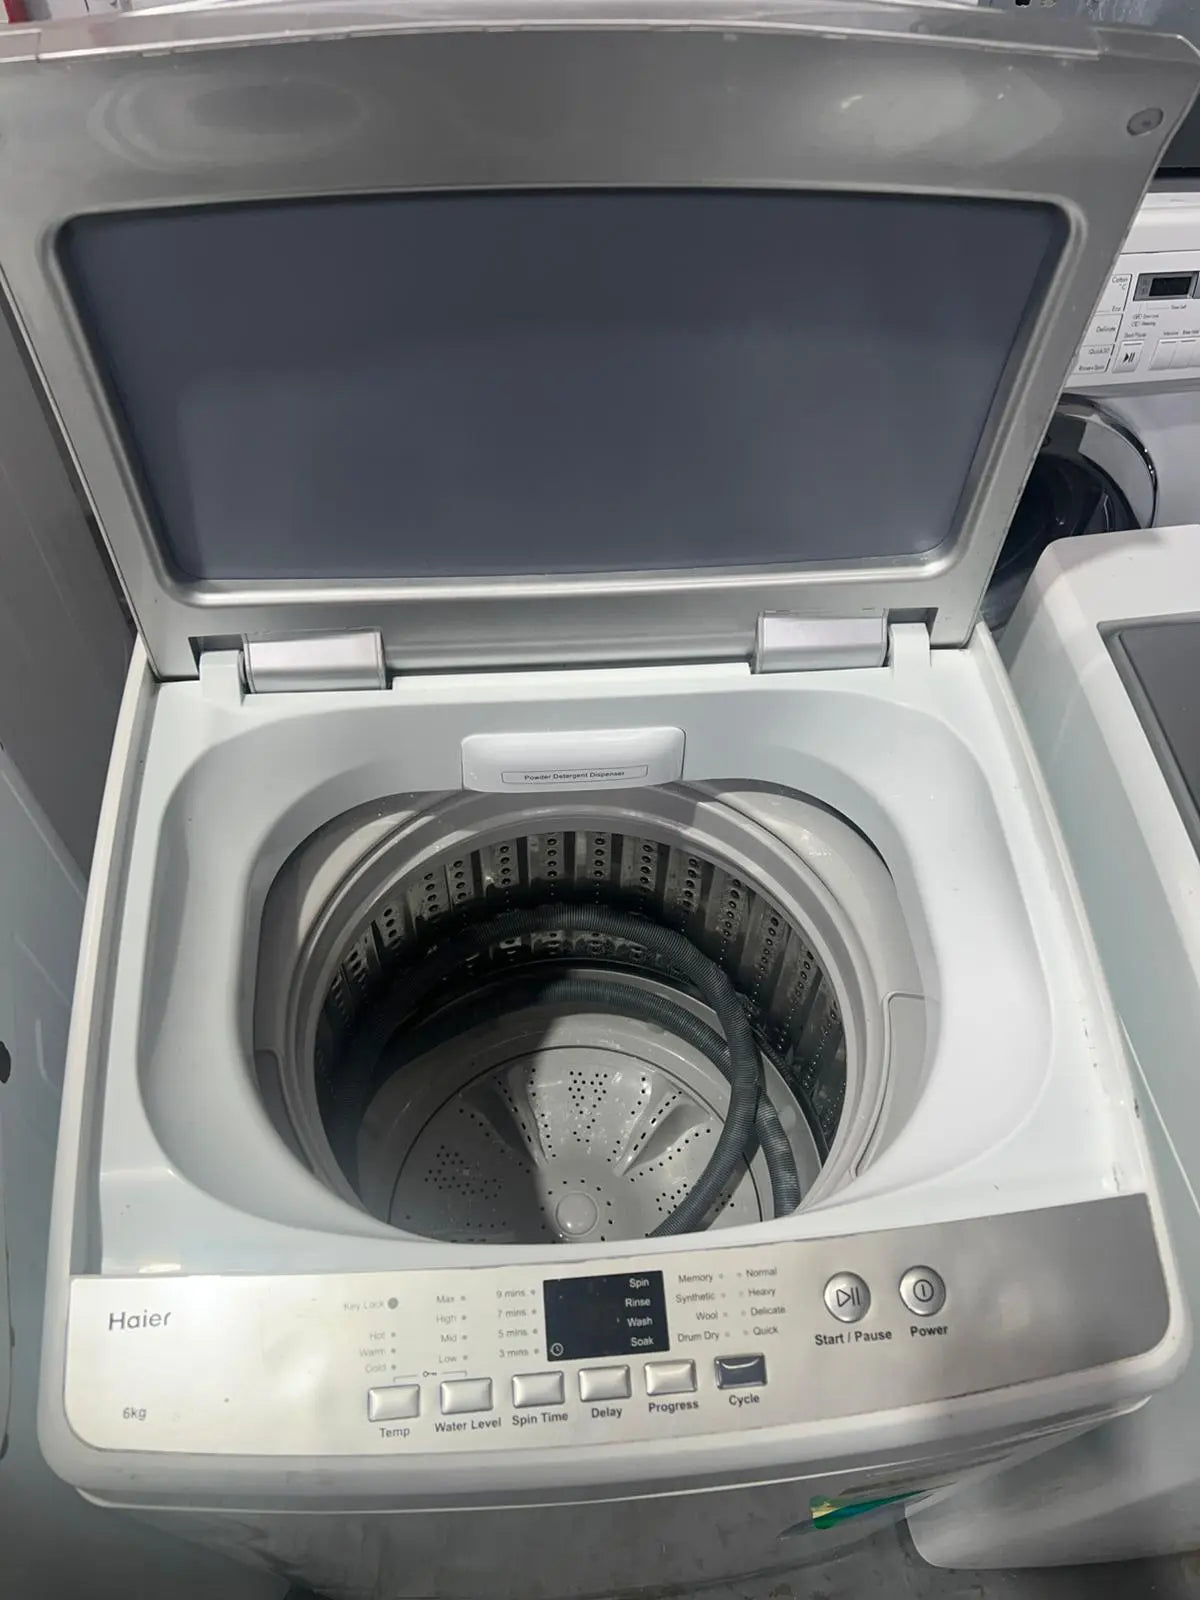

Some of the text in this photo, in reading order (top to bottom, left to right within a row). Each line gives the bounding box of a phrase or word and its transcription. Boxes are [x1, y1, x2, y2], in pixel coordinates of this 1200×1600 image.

[553, 772, 588, 780] Detergent
[746, 1267, 777, 1278] Normal
[629, 1277, 650, 1289] Spin
[678, 1273, 713, 1284] Memory
[505, 1289, 526, 1298] mins
[748, 1287, 776, 1297] Heavy
[436, 1295, 455, 1305] Max
[625, 1298, 651, 1308] Rinse
[676, 1292, 715, 1304] Synthetic
[343, 1299, 385, 1312] Key Lock
[505, 1309, 527, 1317] mins
[696, 1311, 719, 1321] Wool
[751, 1306, 786, 1317] Delicate
[108, 1309, 172, 1331] Haier
[435, 1313, 457, 1325] High
[627, 1317, 653, 1328] Wash
[369, 1330, 386, 1341] Hot
[506, 1328, 528, 1337] mins
[678, 1330, 720, 1342] Drum Dry
[753, 1325, 778, 1336] Quick
[910, 1325, 948, 1337] Power
[440, 1332, 457, 1343] Mid
[631, 1337, 654, 1347] Soak
[814, 1332, 844, 1346] Start
[855, 1330, 893, 1342] Pause
[359, 1347, 386, 1358] Warm
[507, 1348, 529, 1357] mins
[438, 1353, 457, 1364] Low
[729, 1394, 760, 1407] Cycle
[591, 1407, 622, 1419] Delay
[648, 1401, 699, 1414] Progress
[122, 1407, 147, 1421] 6kg
[512, 1411, 568, 1426] Spin Time
[435, 1418, 501, 1433] Water Level
[380, 1427, 410, 1438] Temp
